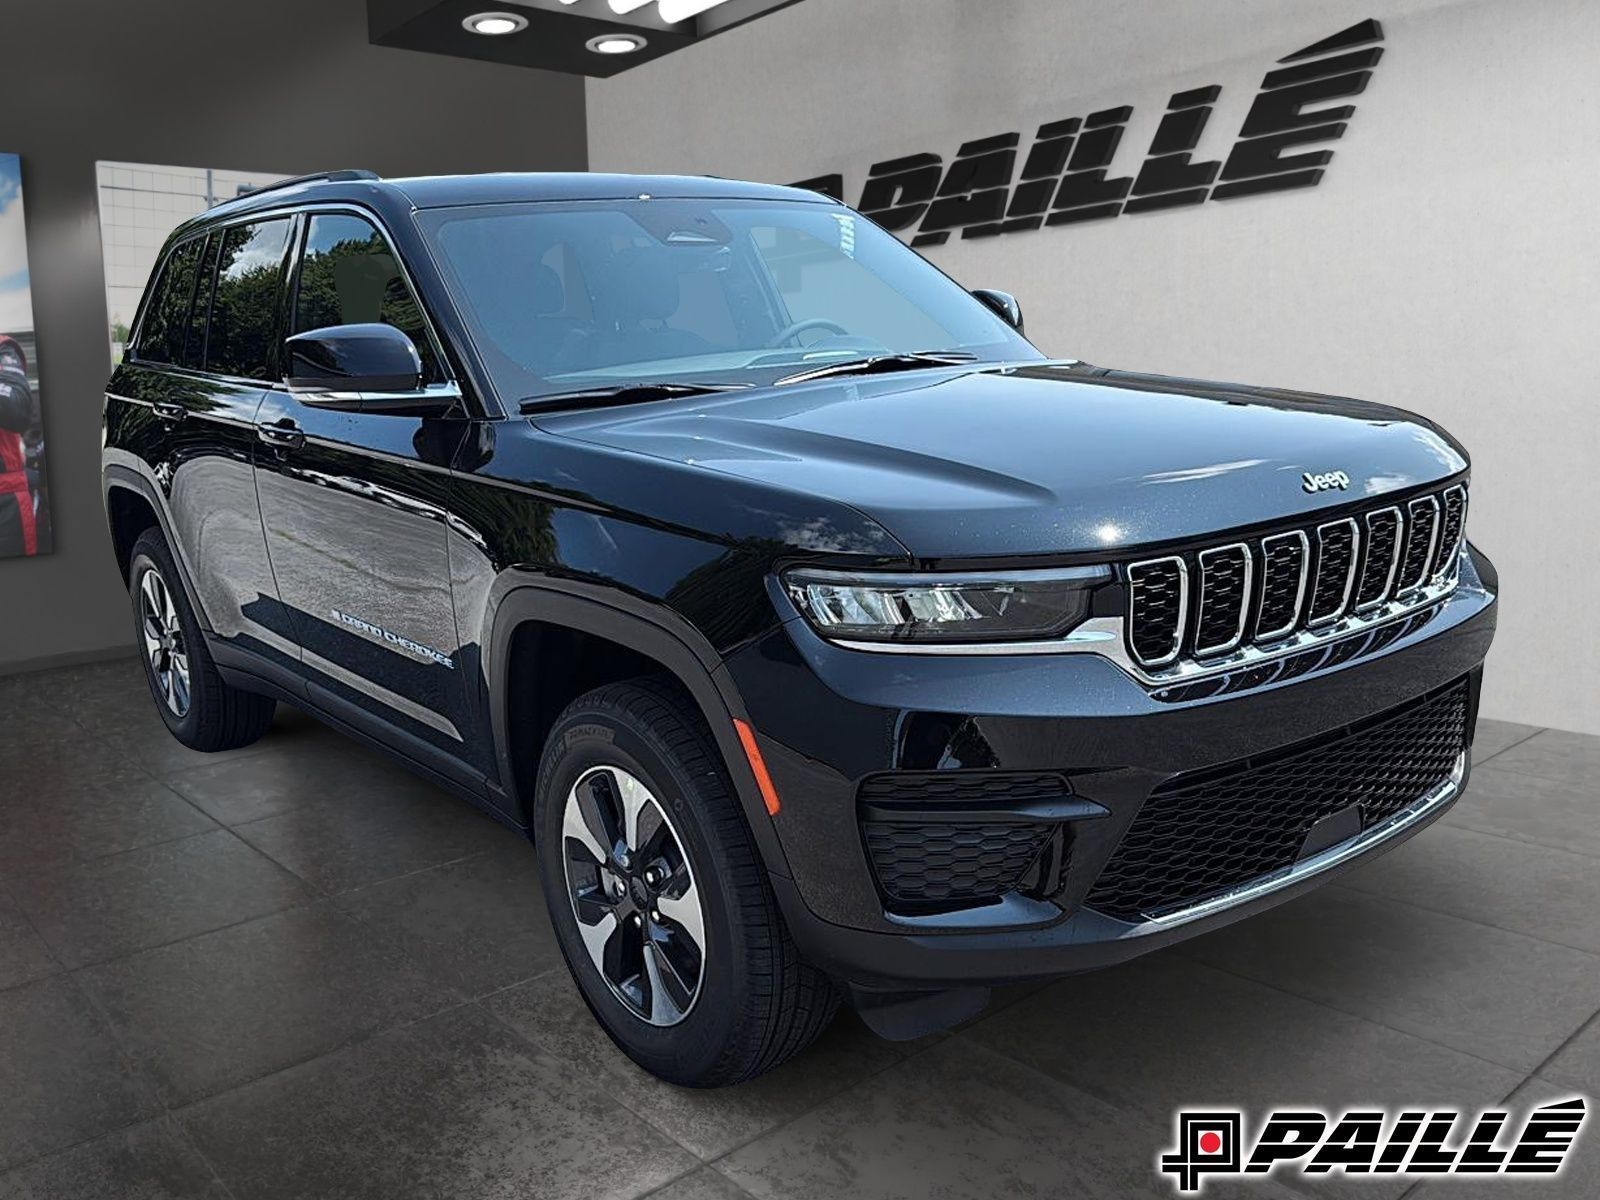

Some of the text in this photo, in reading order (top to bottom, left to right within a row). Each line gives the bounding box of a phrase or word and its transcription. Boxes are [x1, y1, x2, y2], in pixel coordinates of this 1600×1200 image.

[857, 18, 1385, 247] PAILLÉ
[1302, 470, 1350, 493] Jeep
[384, 631, 454, 669] CHEROKEE
